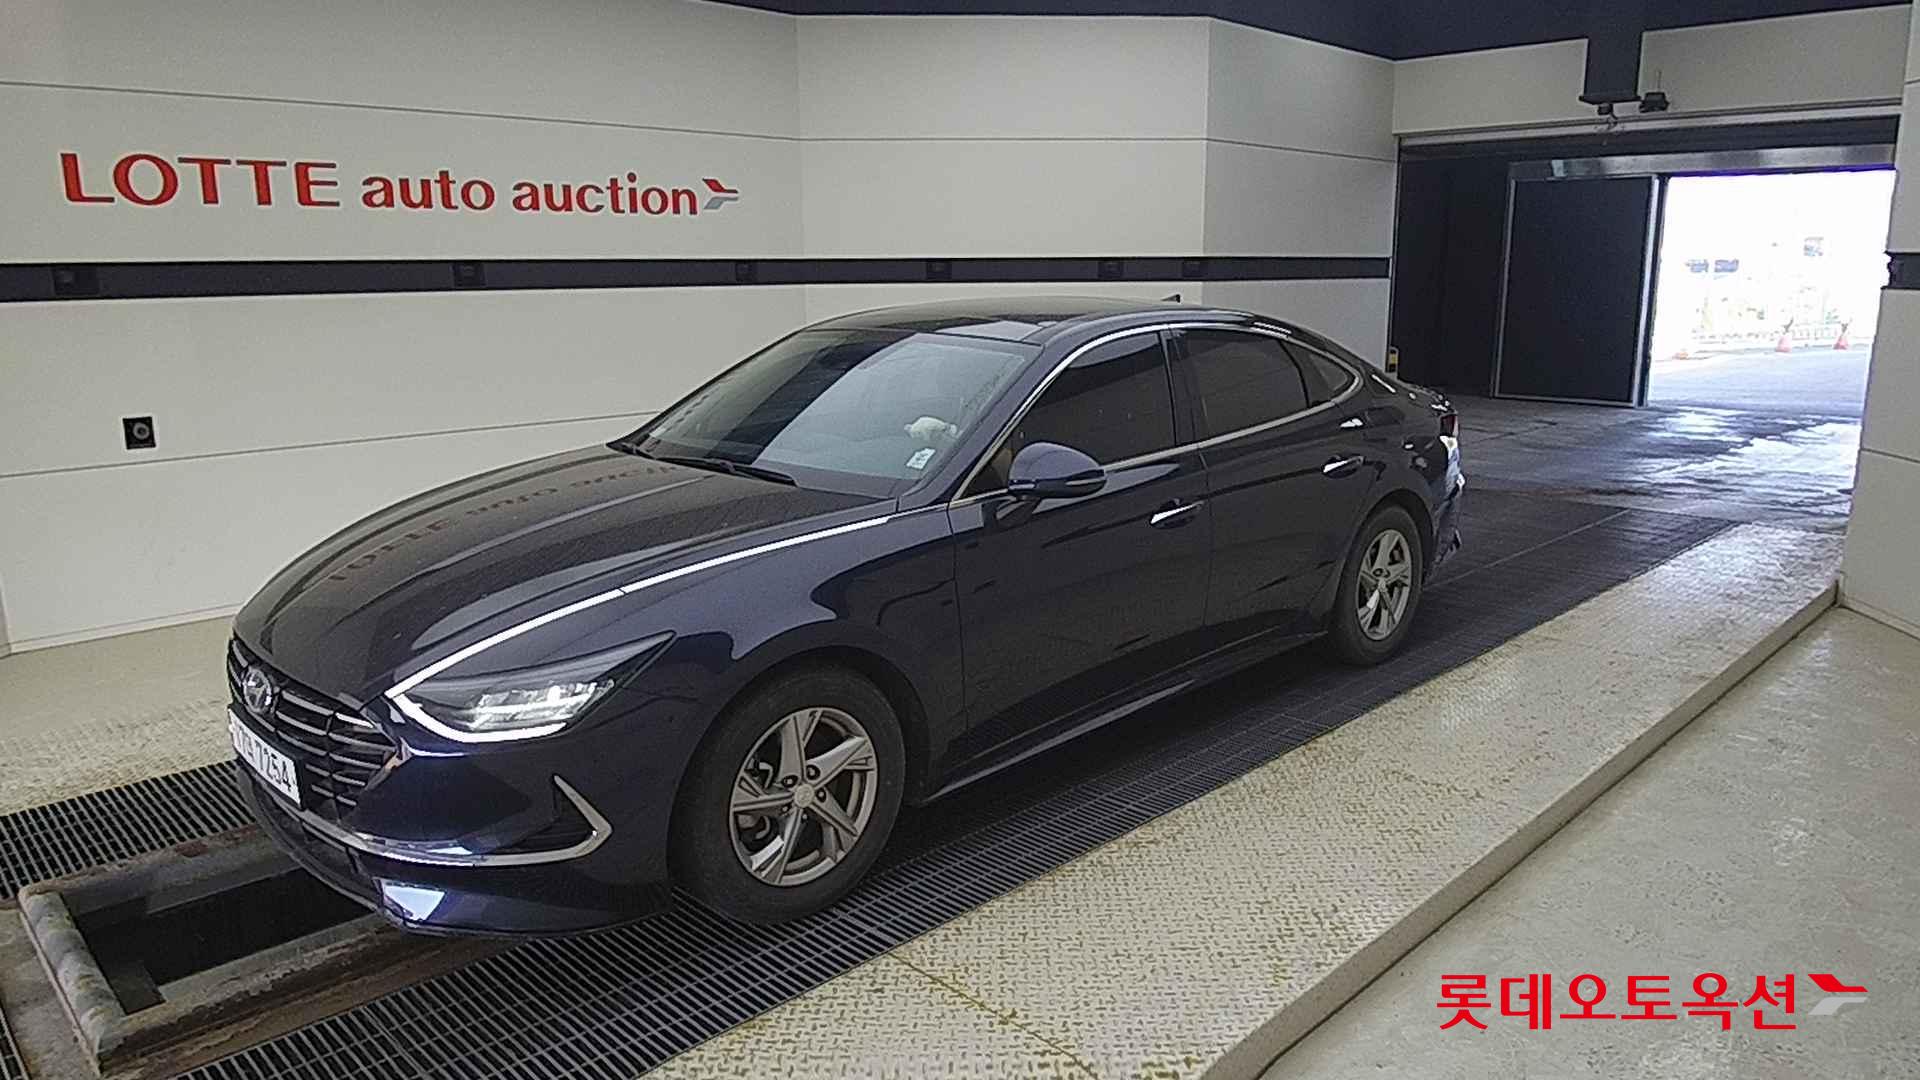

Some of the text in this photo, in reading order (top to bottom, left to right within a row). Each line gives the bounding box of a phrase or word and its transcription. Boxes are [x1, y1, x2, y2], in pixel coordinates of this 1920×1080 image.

[61, 153, 698, 215] LOTTE auto auction
